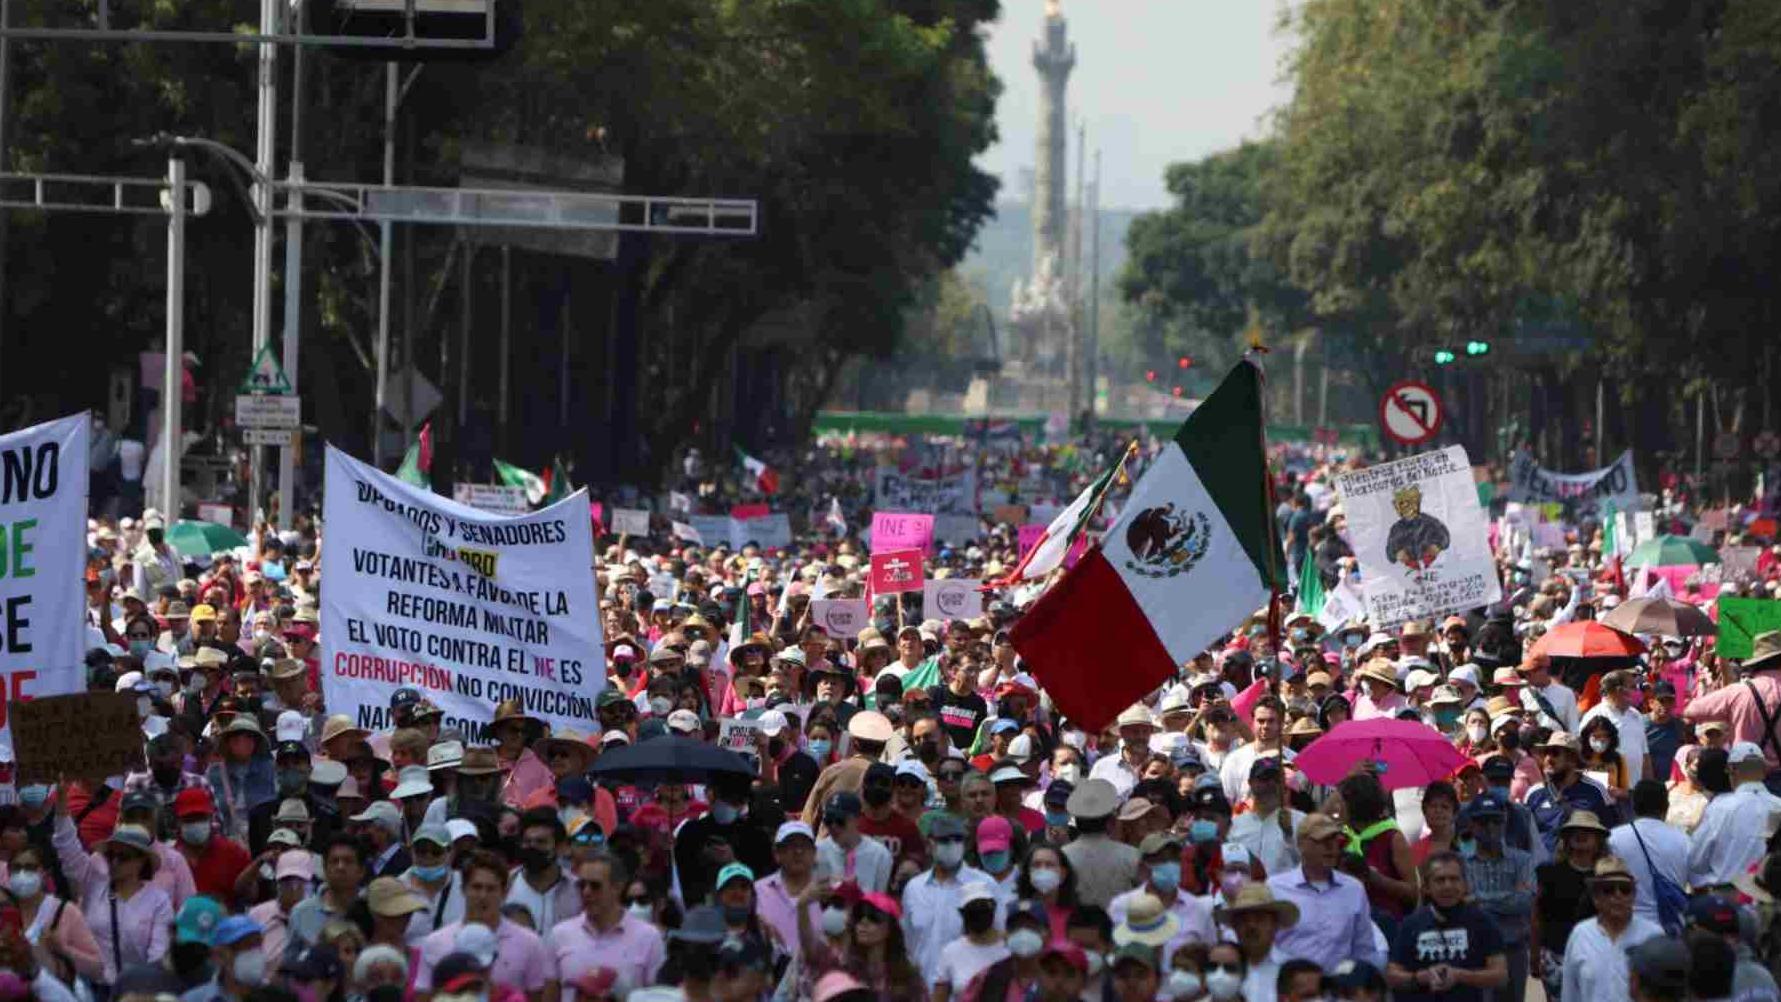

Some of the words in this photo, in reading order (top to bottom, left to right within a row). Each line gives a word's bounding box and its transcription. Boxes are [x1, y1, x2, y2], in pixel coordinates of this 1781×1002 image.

[3, 441, 59, 505] NO
[444, 516, 456, 537] Y
[459, 520, 567, 547] SENADORES
[352, 547, 451, 590] VOTANTES
[545, 590, 569, 615] LA
[386, 590, 478, 630] REFORMA
[347, 618, 371, 644] EL
[373, 622, 422, 653] VOTO
[426, 633, 503, 671] CONTRA
[507, 648, 530, 675] EL
[560, 659, 584, 685] ES
[334, 650, 454, 693] CORRUPCIÓN
[456, 673, 483, 698] NO
[486, 680, 595, 722] CONVICCIÓN
